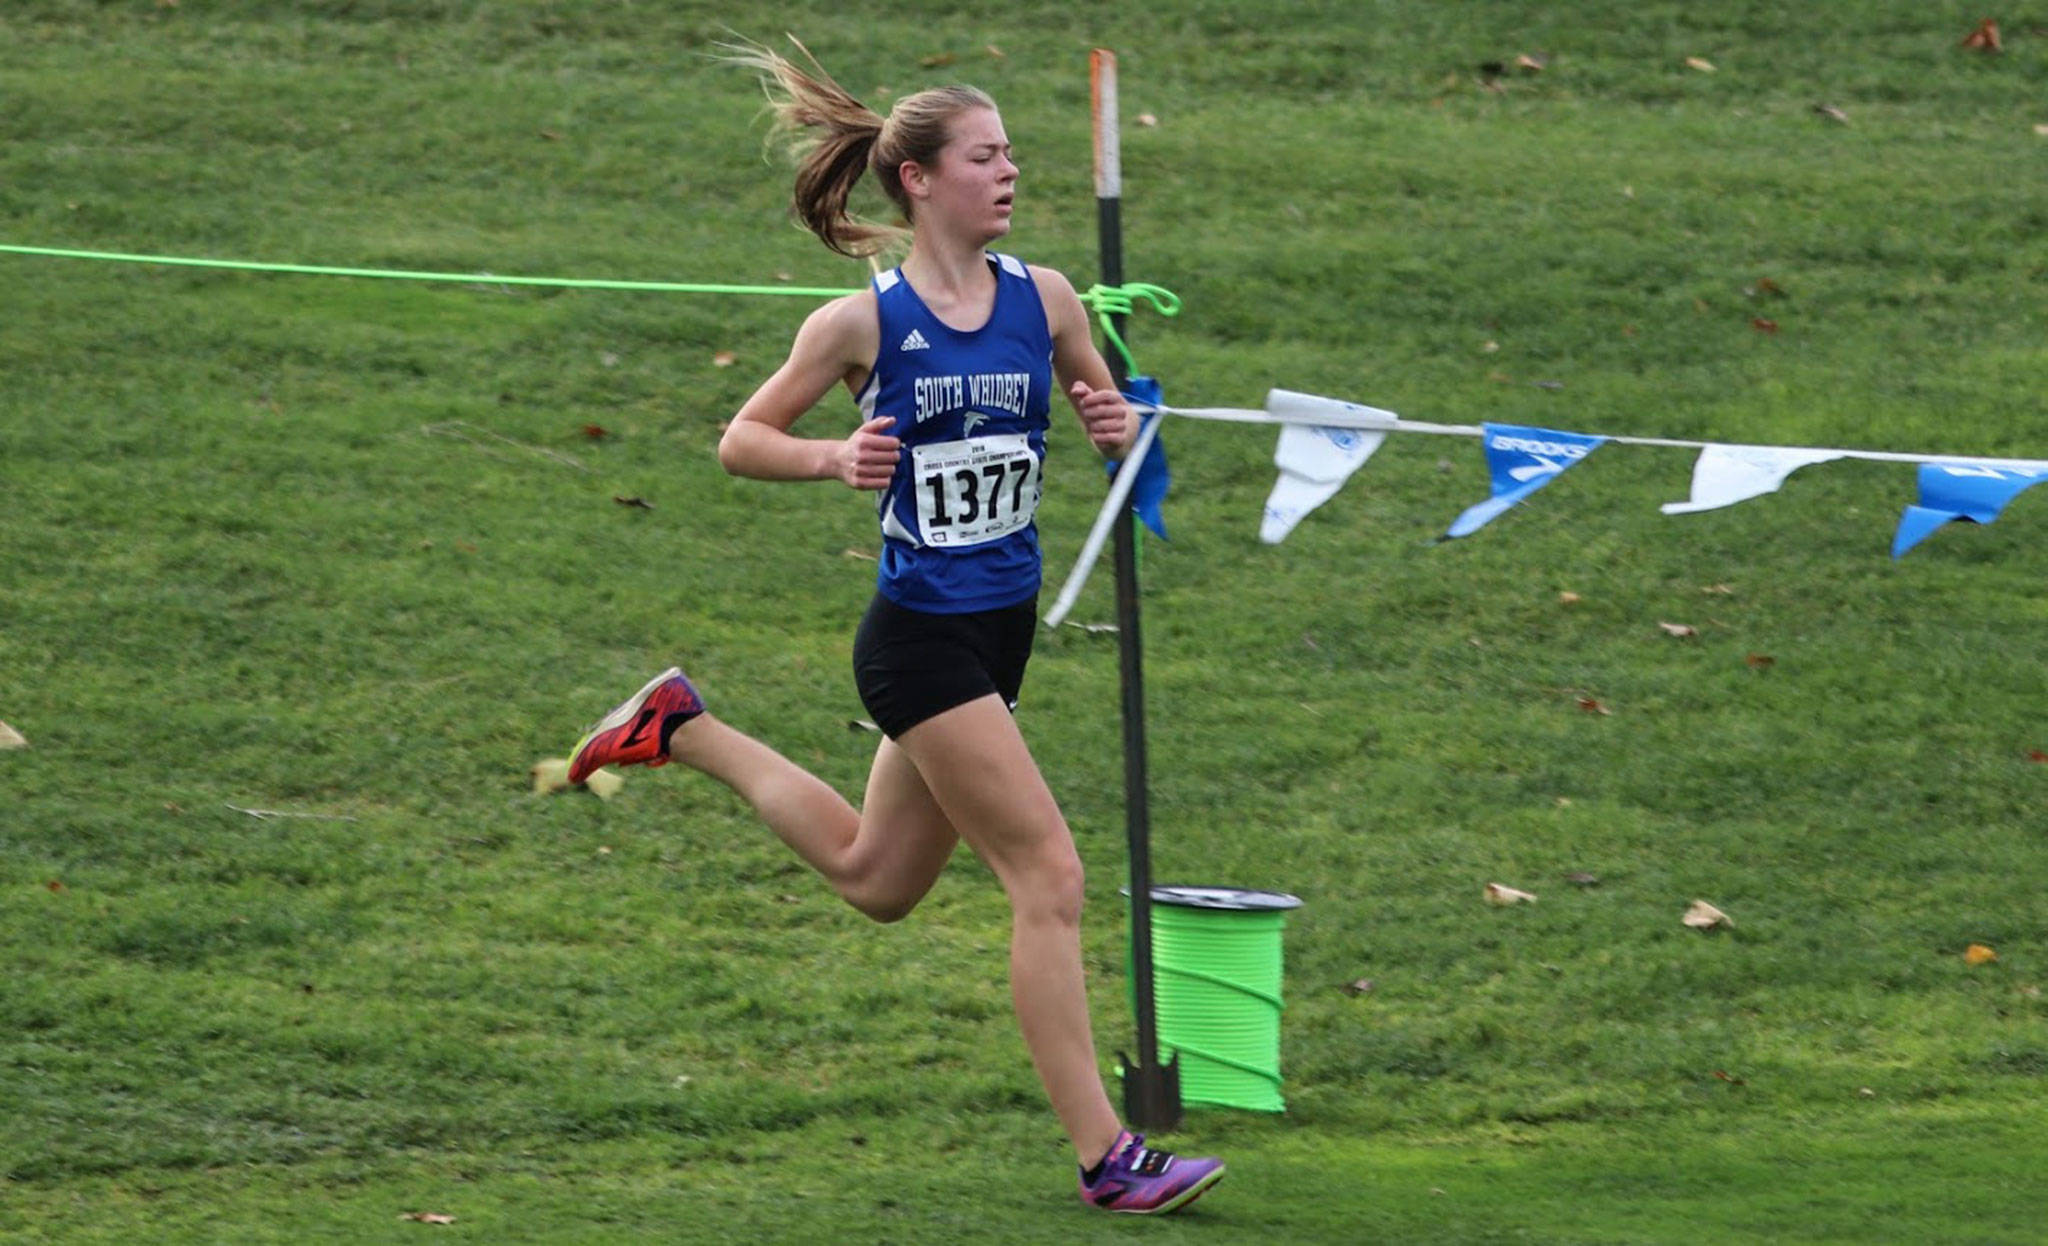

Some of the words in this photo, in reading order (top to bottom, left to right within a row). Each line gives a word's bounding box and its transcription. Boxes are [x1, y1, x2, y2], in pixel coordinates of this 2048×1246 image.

[914, 375, 964, 424] SOUTH
[968, 373, 1030, 418] WHIDBEY
[926, 458, 1032, 527] 1377
